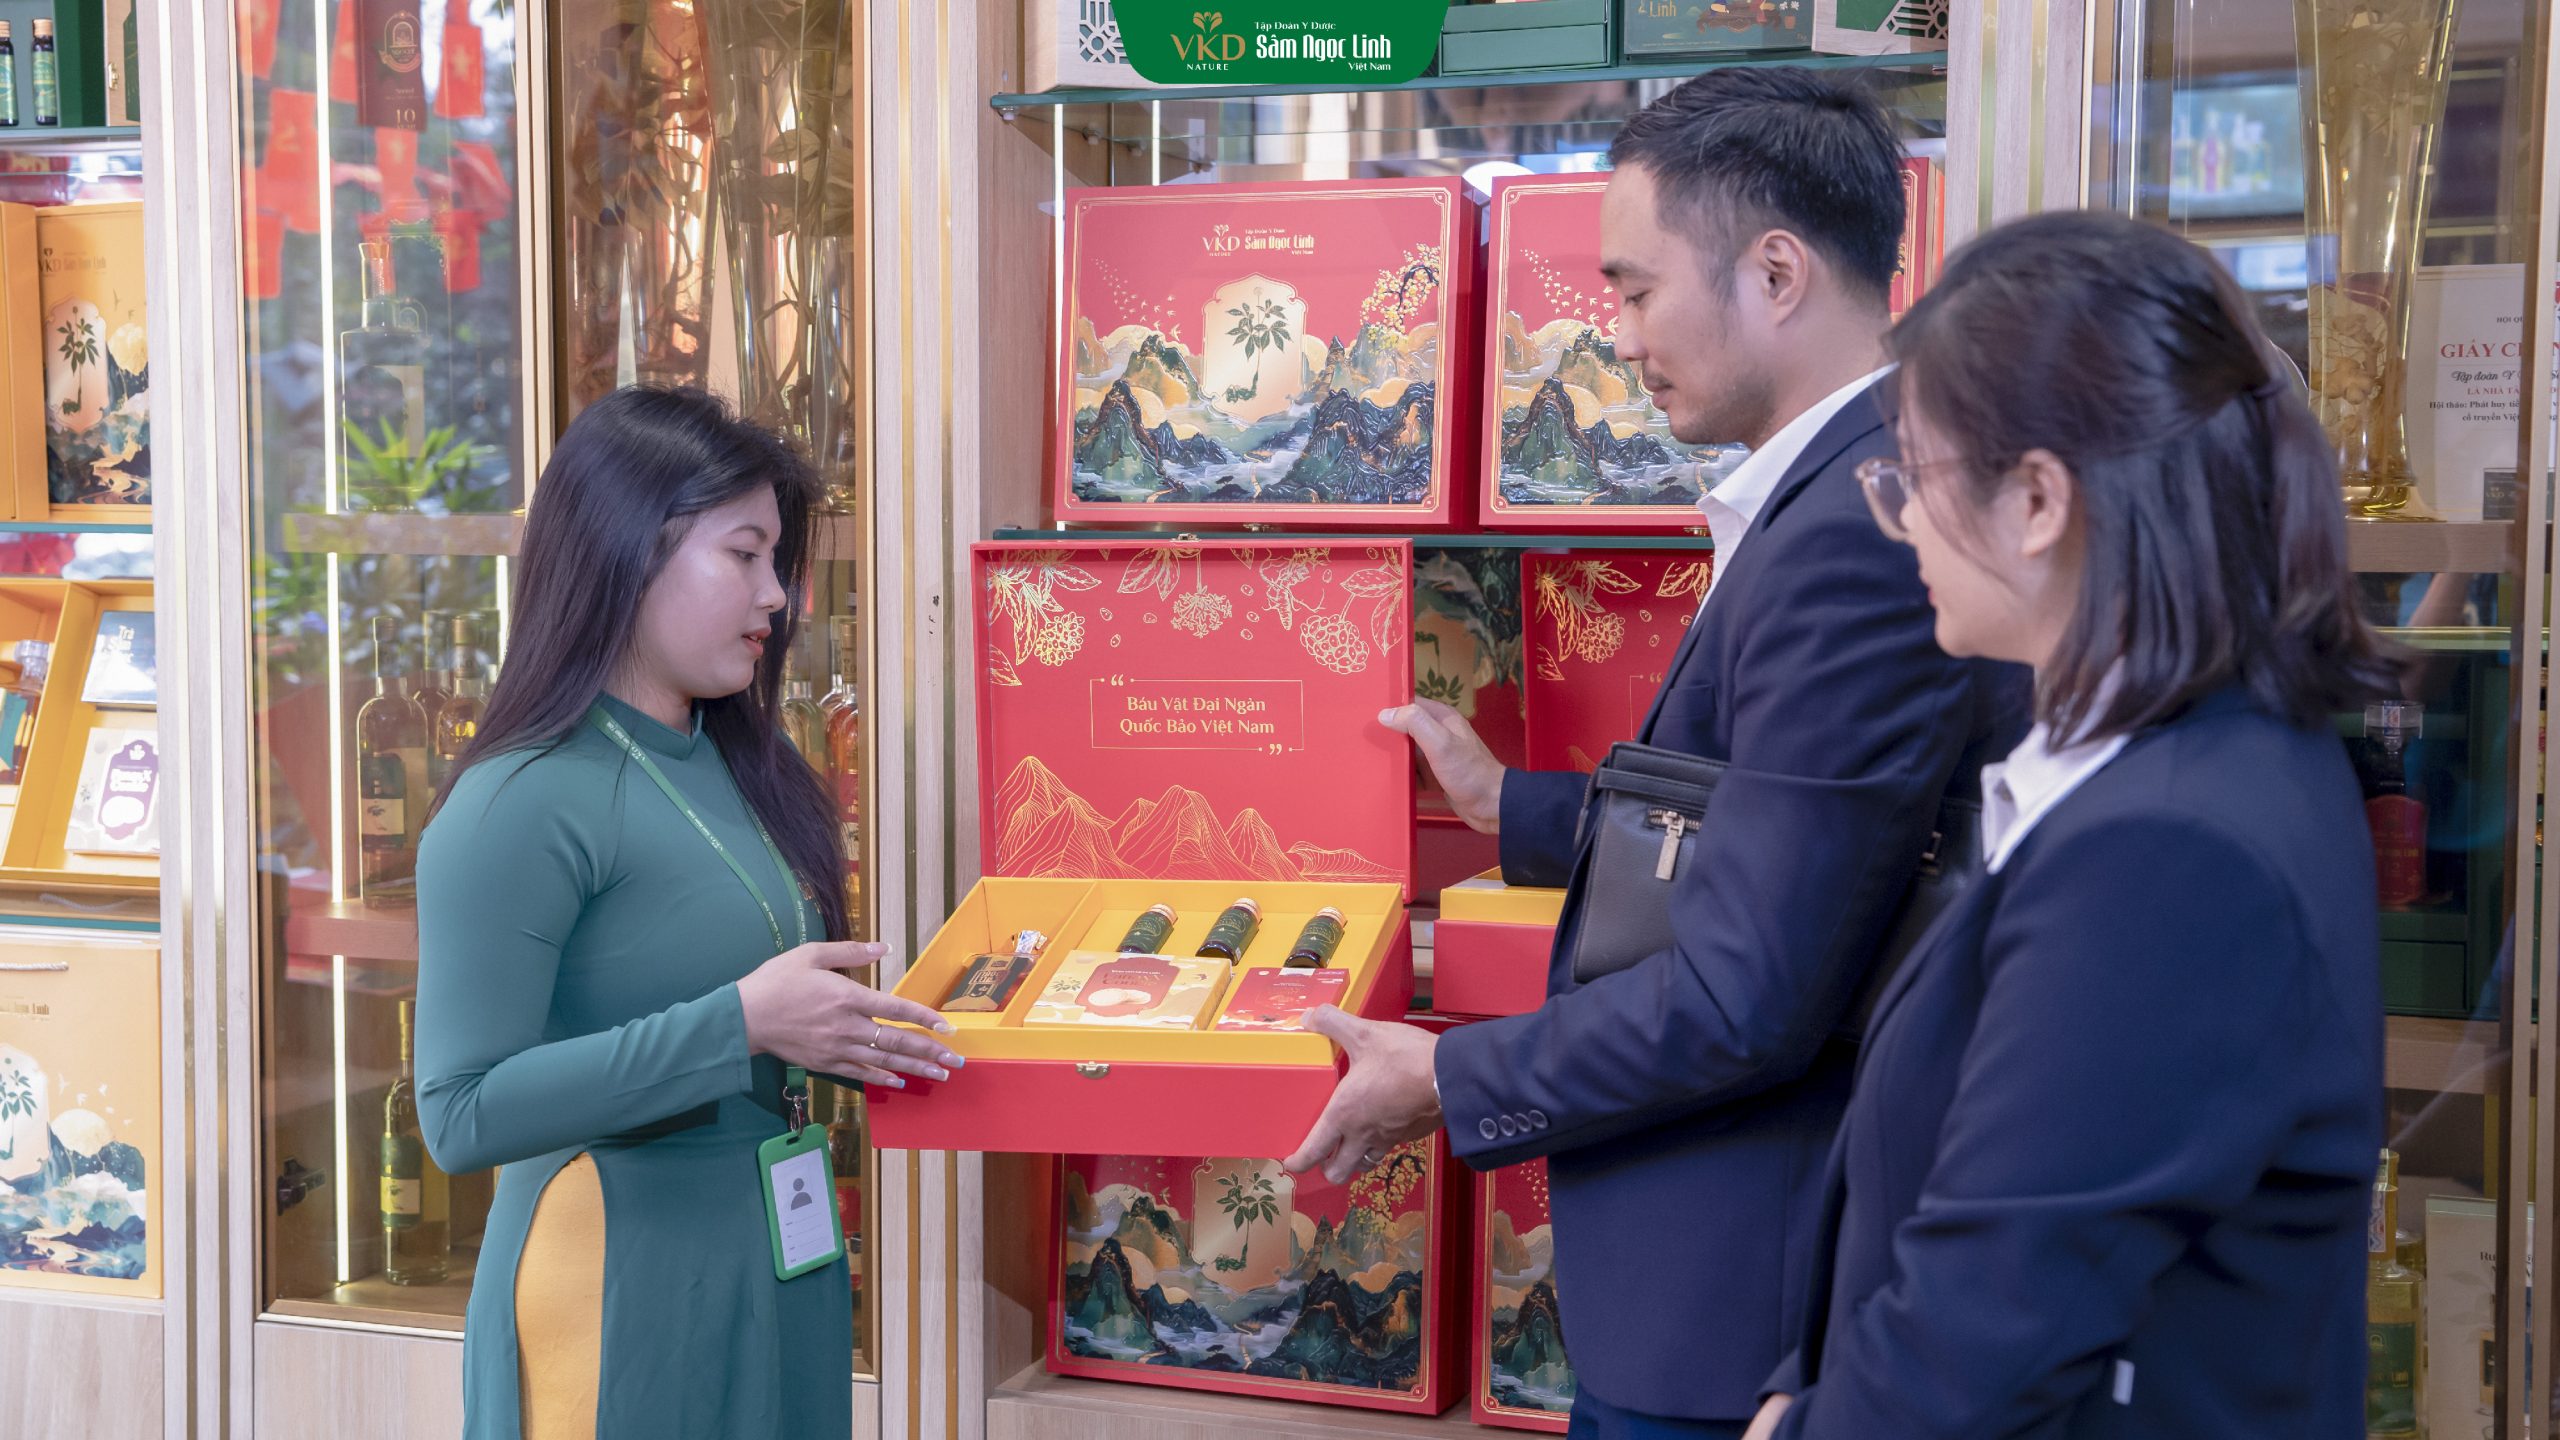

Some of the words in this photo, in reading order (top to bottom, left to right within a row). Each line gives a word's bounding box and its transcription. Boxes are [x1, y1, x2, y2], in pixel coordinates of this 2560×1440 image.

[1202, 236, 1241, 252] VKD
[1126, 695, 1158, 711] Báu
[1160, 696, 1189, 714] Vật
[1192, 696, 1220, 714] Đại
[1224, 697, 1266, 715] Ngàn
[1119, 717, 1162, 736] Quốc
[1166, 717, 1197, 733] Bảo
[1200, 719, 1233, 737] Việt
[1238, 719, 1275, 734] Nam
